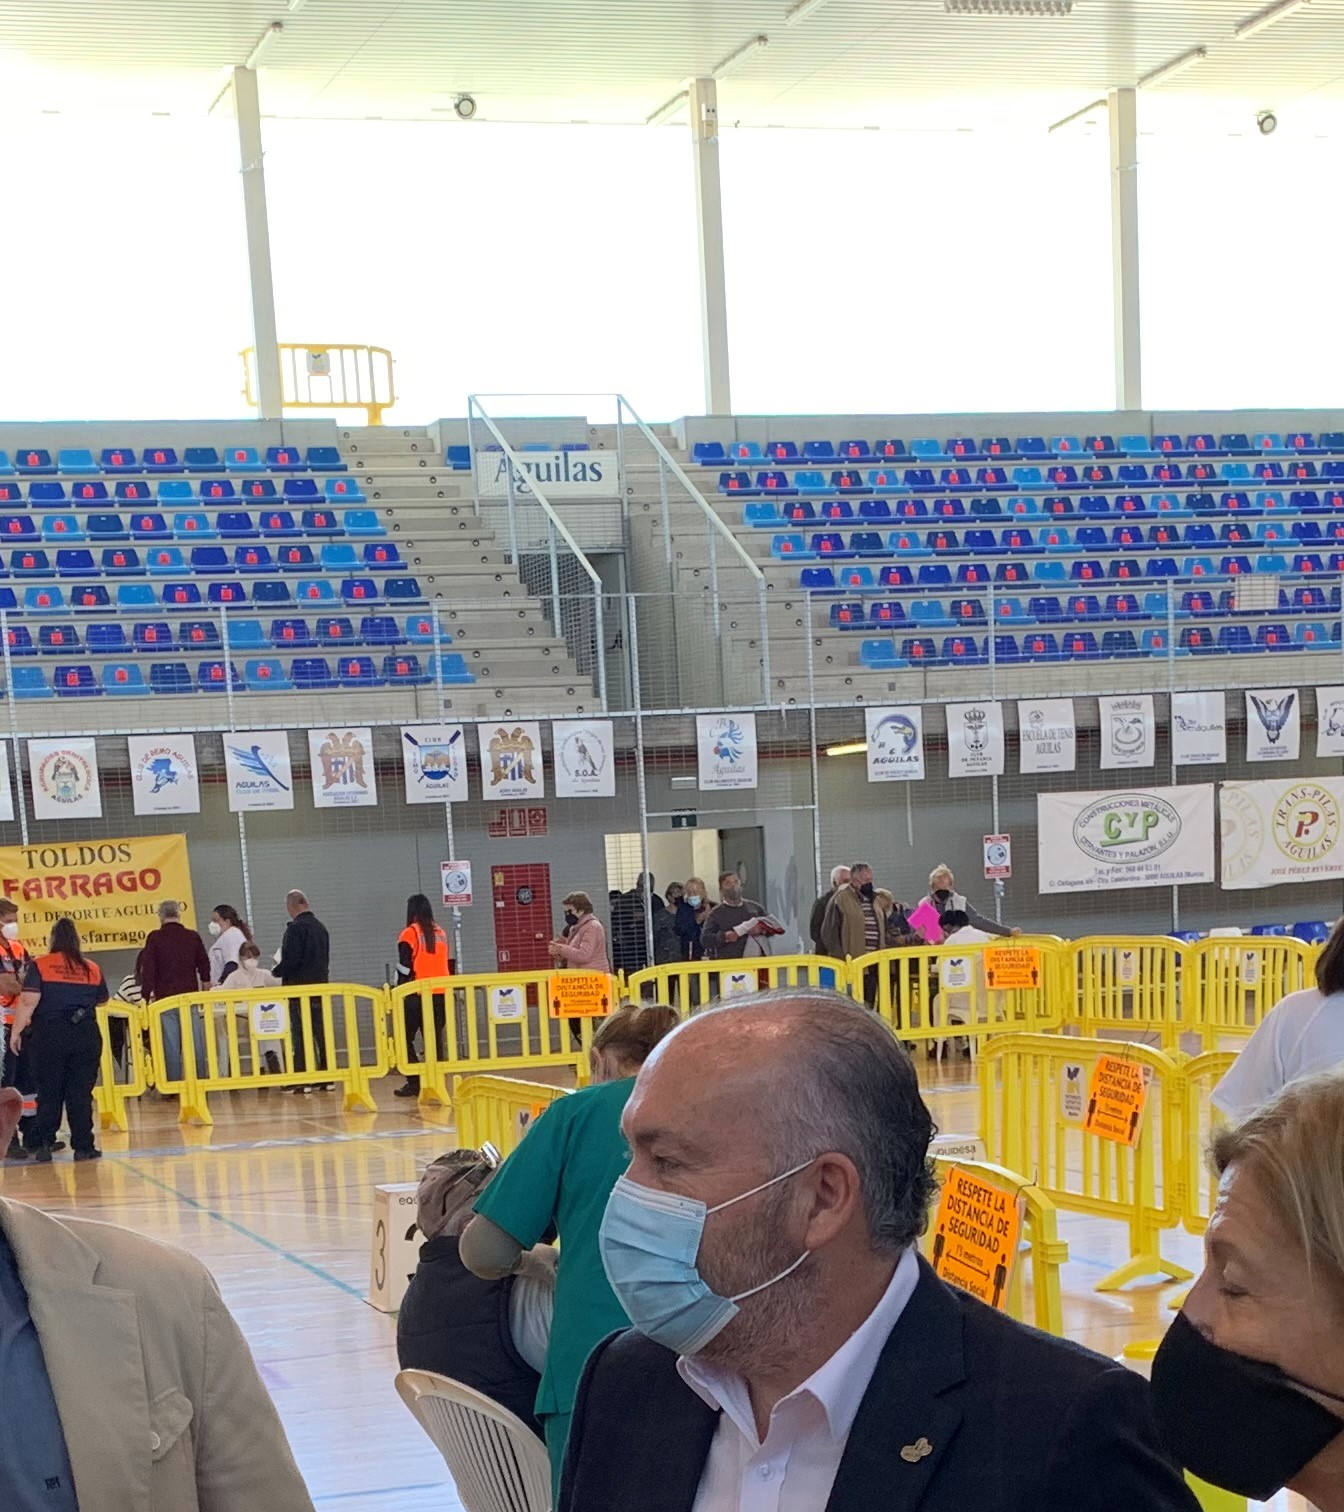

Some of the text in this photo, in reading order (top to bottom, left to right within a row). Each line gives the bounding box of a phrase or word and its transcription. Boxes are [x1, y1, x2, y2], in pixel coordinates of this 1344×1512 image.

[1079, 800, 1140, 828] CONSTRUCCIONES
[21, 842, 133, 870] TOLDOS
[2, 867, 162, 902] FARRAGO
[23, 901, 189, 925] EL DEPORTE AGUILO
[957, 1177, 1006, 1214] RESPETE LA
[947, 1195, 1011, 1238] DISTANCIA DE
[948, 1215, 1000, 1254] SEGURIDAD
[964, 1252, 984, 1268] metros
[942, 1267, 987, 1300] Distancia Social
